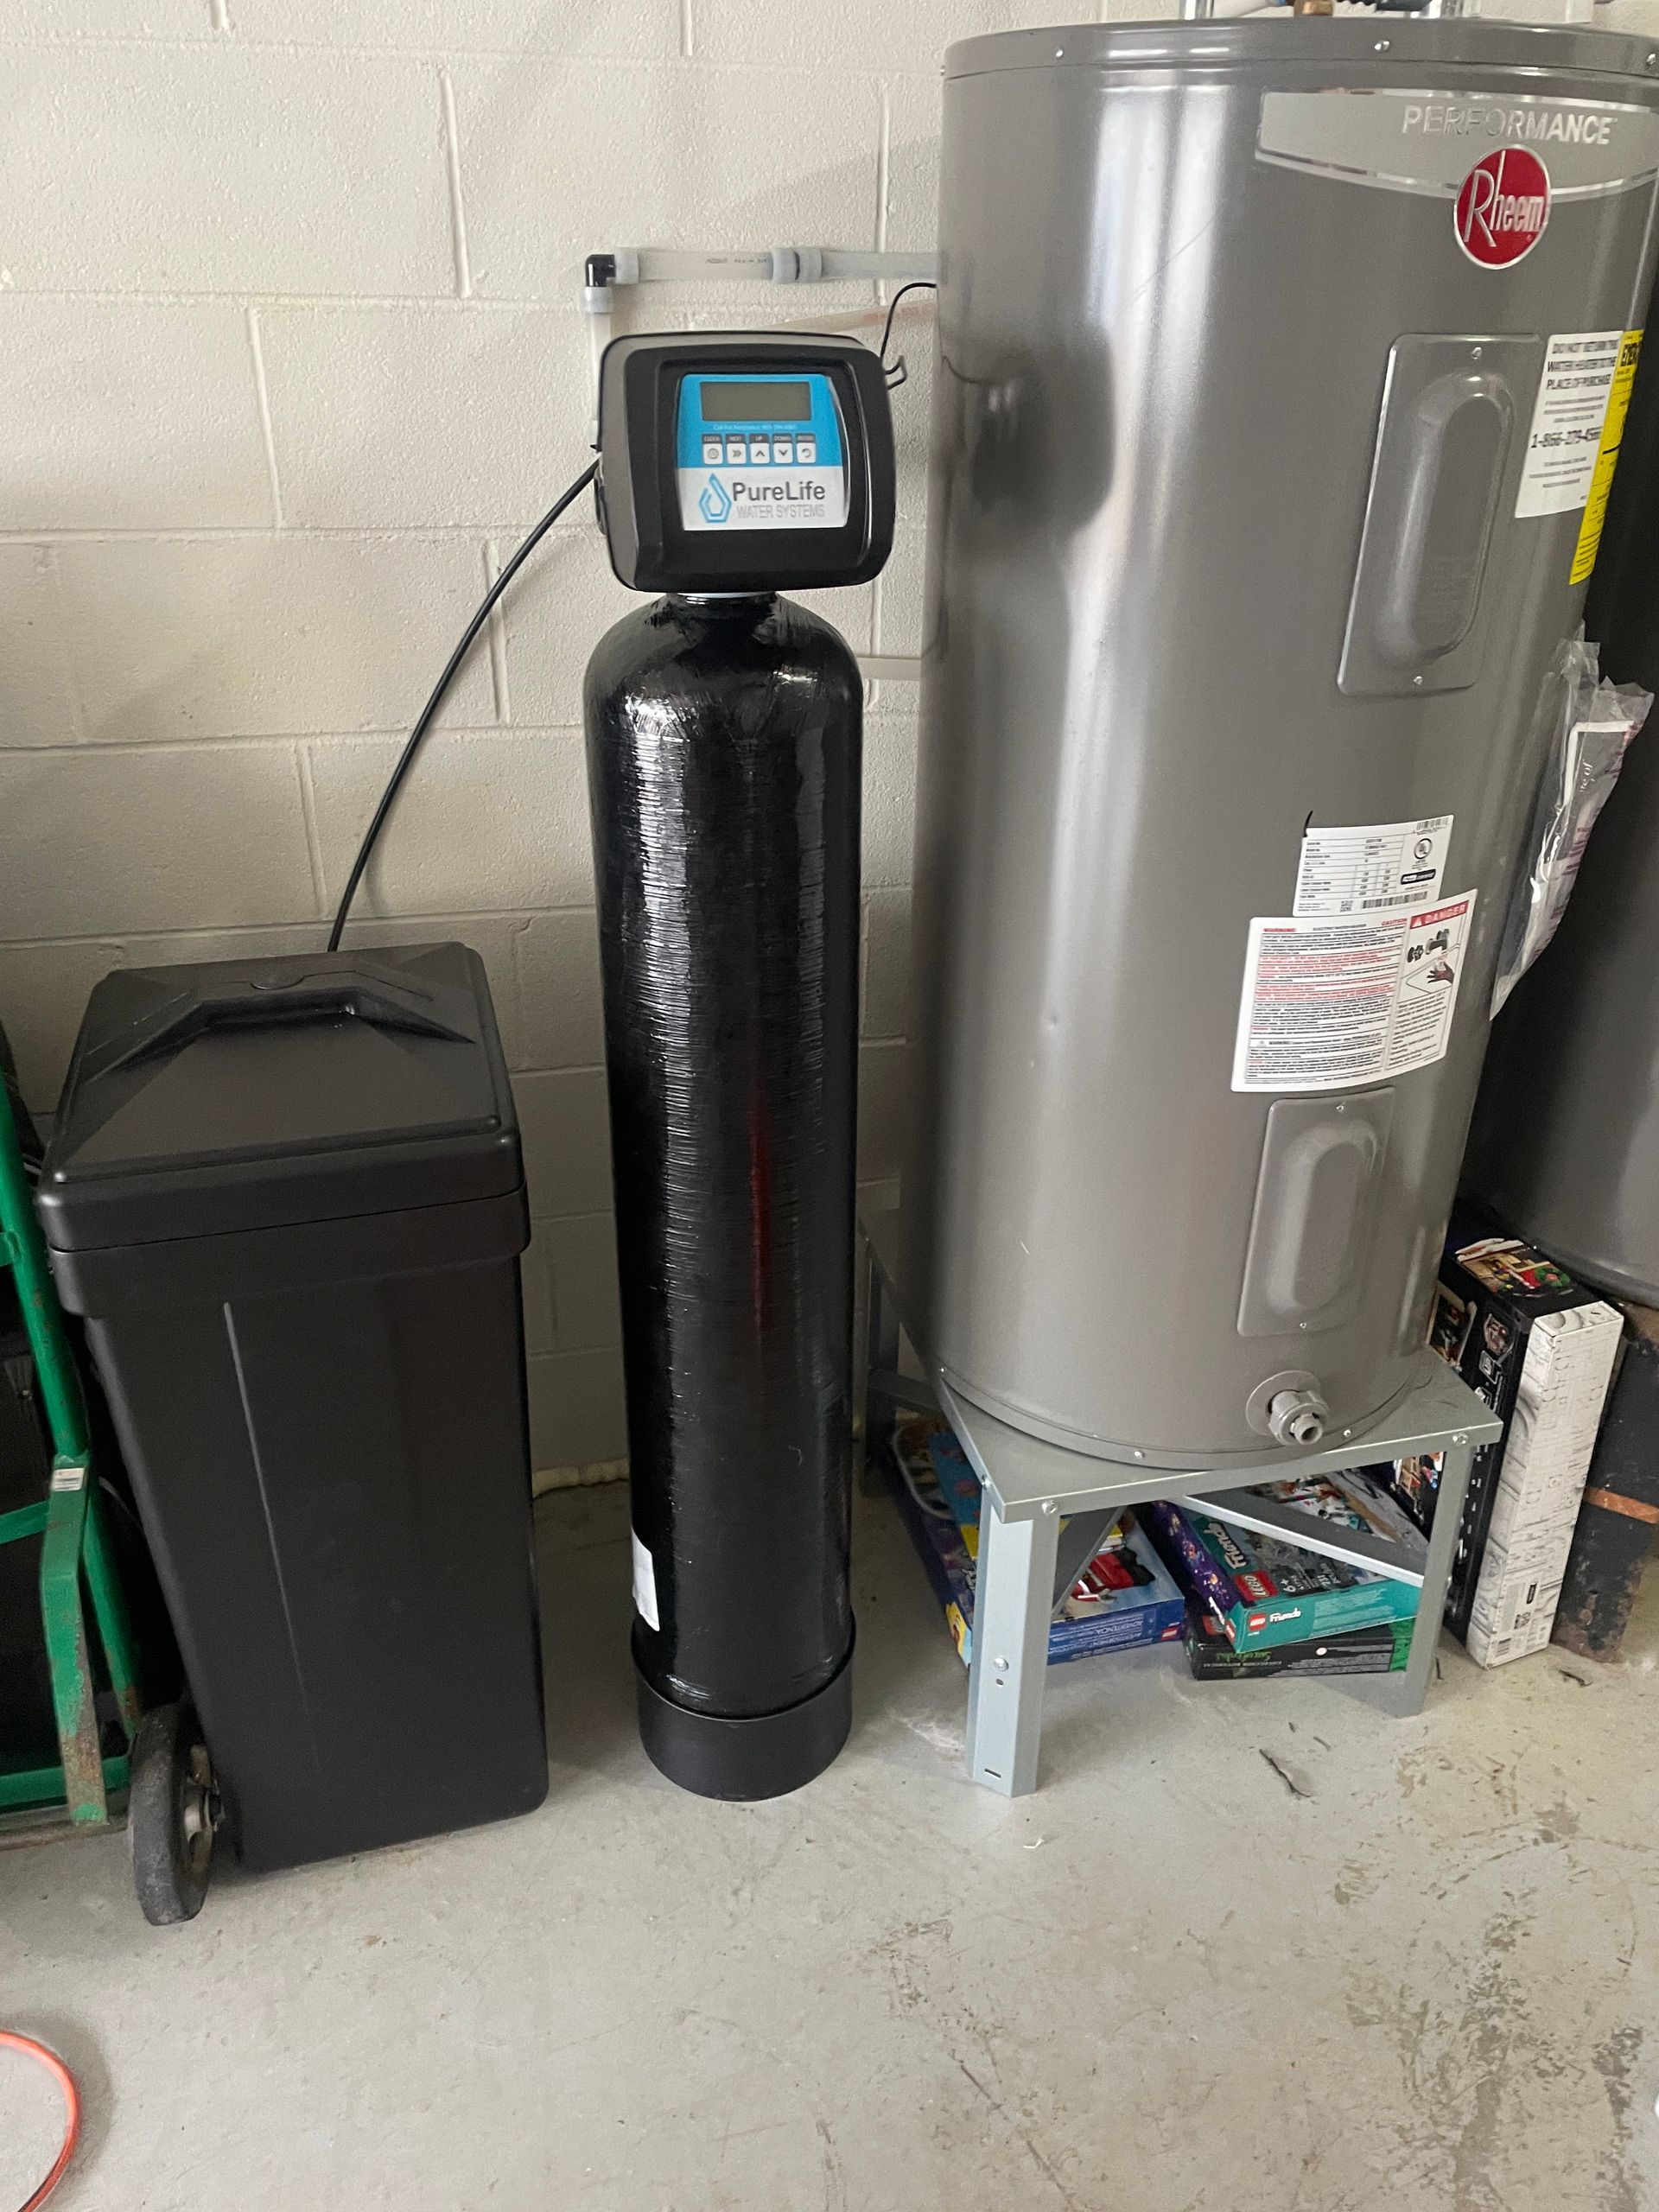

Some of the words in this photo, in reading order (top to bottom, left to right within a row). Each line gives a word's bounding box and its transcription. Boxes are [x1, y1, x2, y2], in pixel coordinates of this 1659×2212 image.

[1402, 105, 1616, 145] PERFORMANCE
[1463, 149, 1545, 248] Rheem
[733, 480, 826, 502] PureLife
[737, 505, 773, 518] WATER
[776, 504, 826, 518] SYSTEMS
[1205, 1522, 1248, 1570] Friends
[1244, 1574, 1267, 1597] LEGO
[1281, 1578, 1296, 1592] 6+
[1269, 1607, 1302, 1623] Friends
